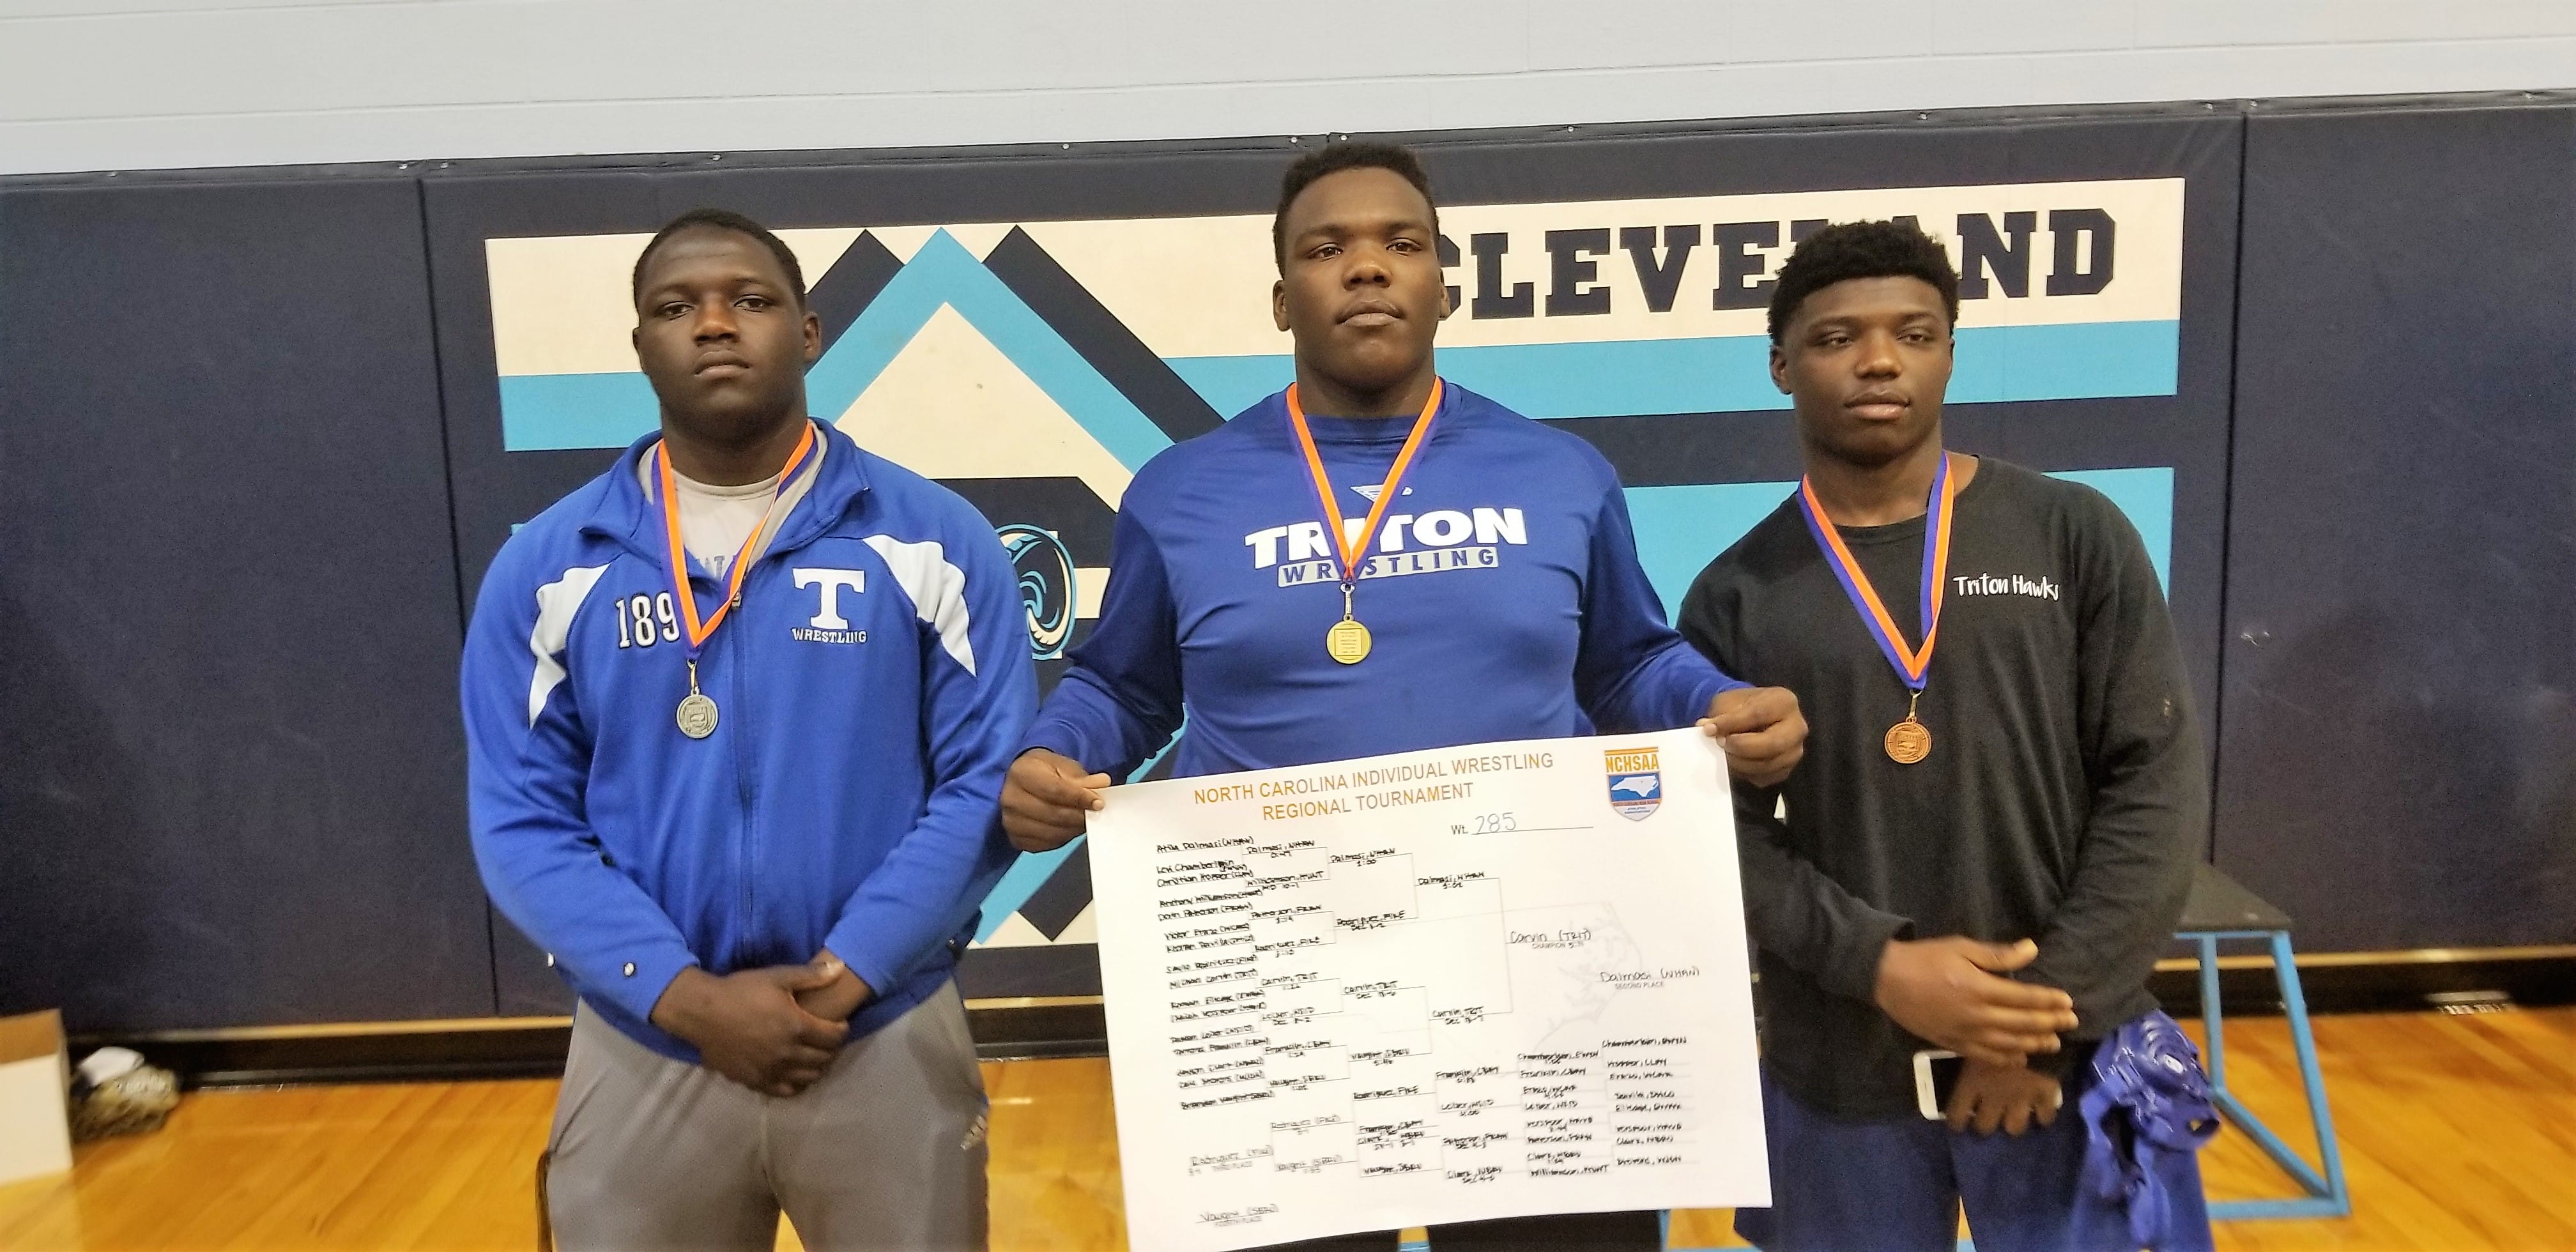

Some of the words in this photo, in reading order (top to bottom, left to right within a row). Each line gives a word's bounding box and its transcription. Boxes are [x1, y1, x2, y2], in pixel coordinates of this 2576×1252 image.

[1285, 549, 1494, 583] WRSTLING
[1952, 572, 2009, 596] Triton
[792, 568, 865, 630] T
[616, 592, 680, 648] 189
[1194, 784, 1254, 804] NORTH
[1260, 775, 1347, 798] CAROLINA
[1353, 762, 1448, 787] INDIVIDUAL
[1452, 753, 1554, 775] WRESTLING
[1605, 754, 1660, 774] NCHSAA
[1262, 801, 1352, 821] REGIONAL
[1356, 782, 1473, 811] TOURNAMENT
[1475, 813, 1516, 834] 285
